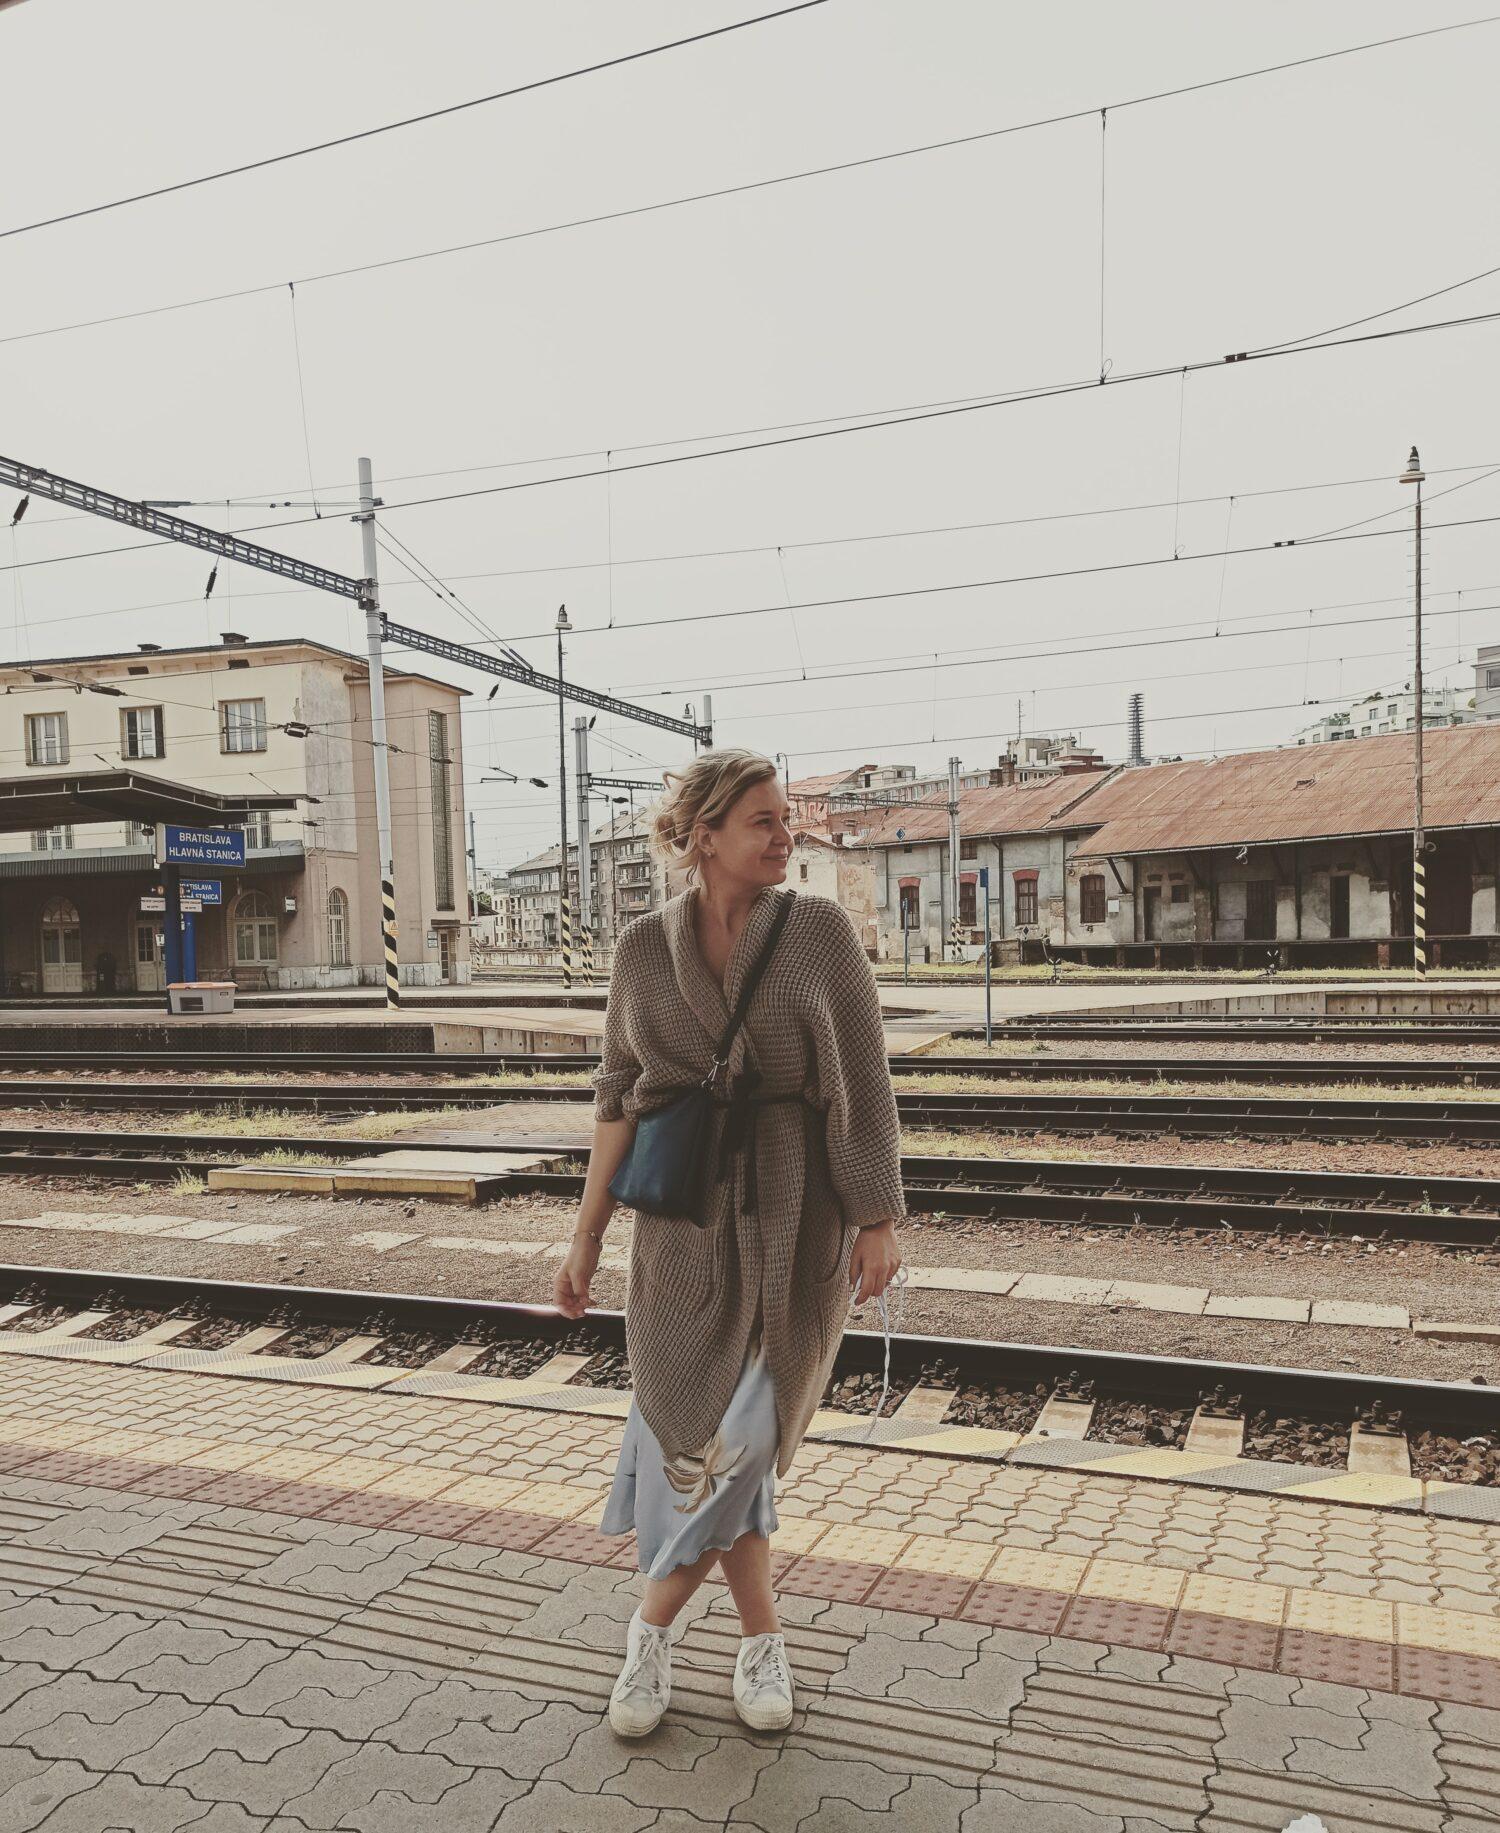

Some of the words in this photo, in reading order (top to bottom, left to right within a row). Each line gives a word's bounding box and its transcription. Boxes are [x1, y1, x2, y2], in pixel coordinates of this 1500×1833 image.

[179, 832, 232, 845] BRATISLAVA
[169, 846, 204, 858] HLAVNÁ
[206, 849, 242, 860] STANICA
